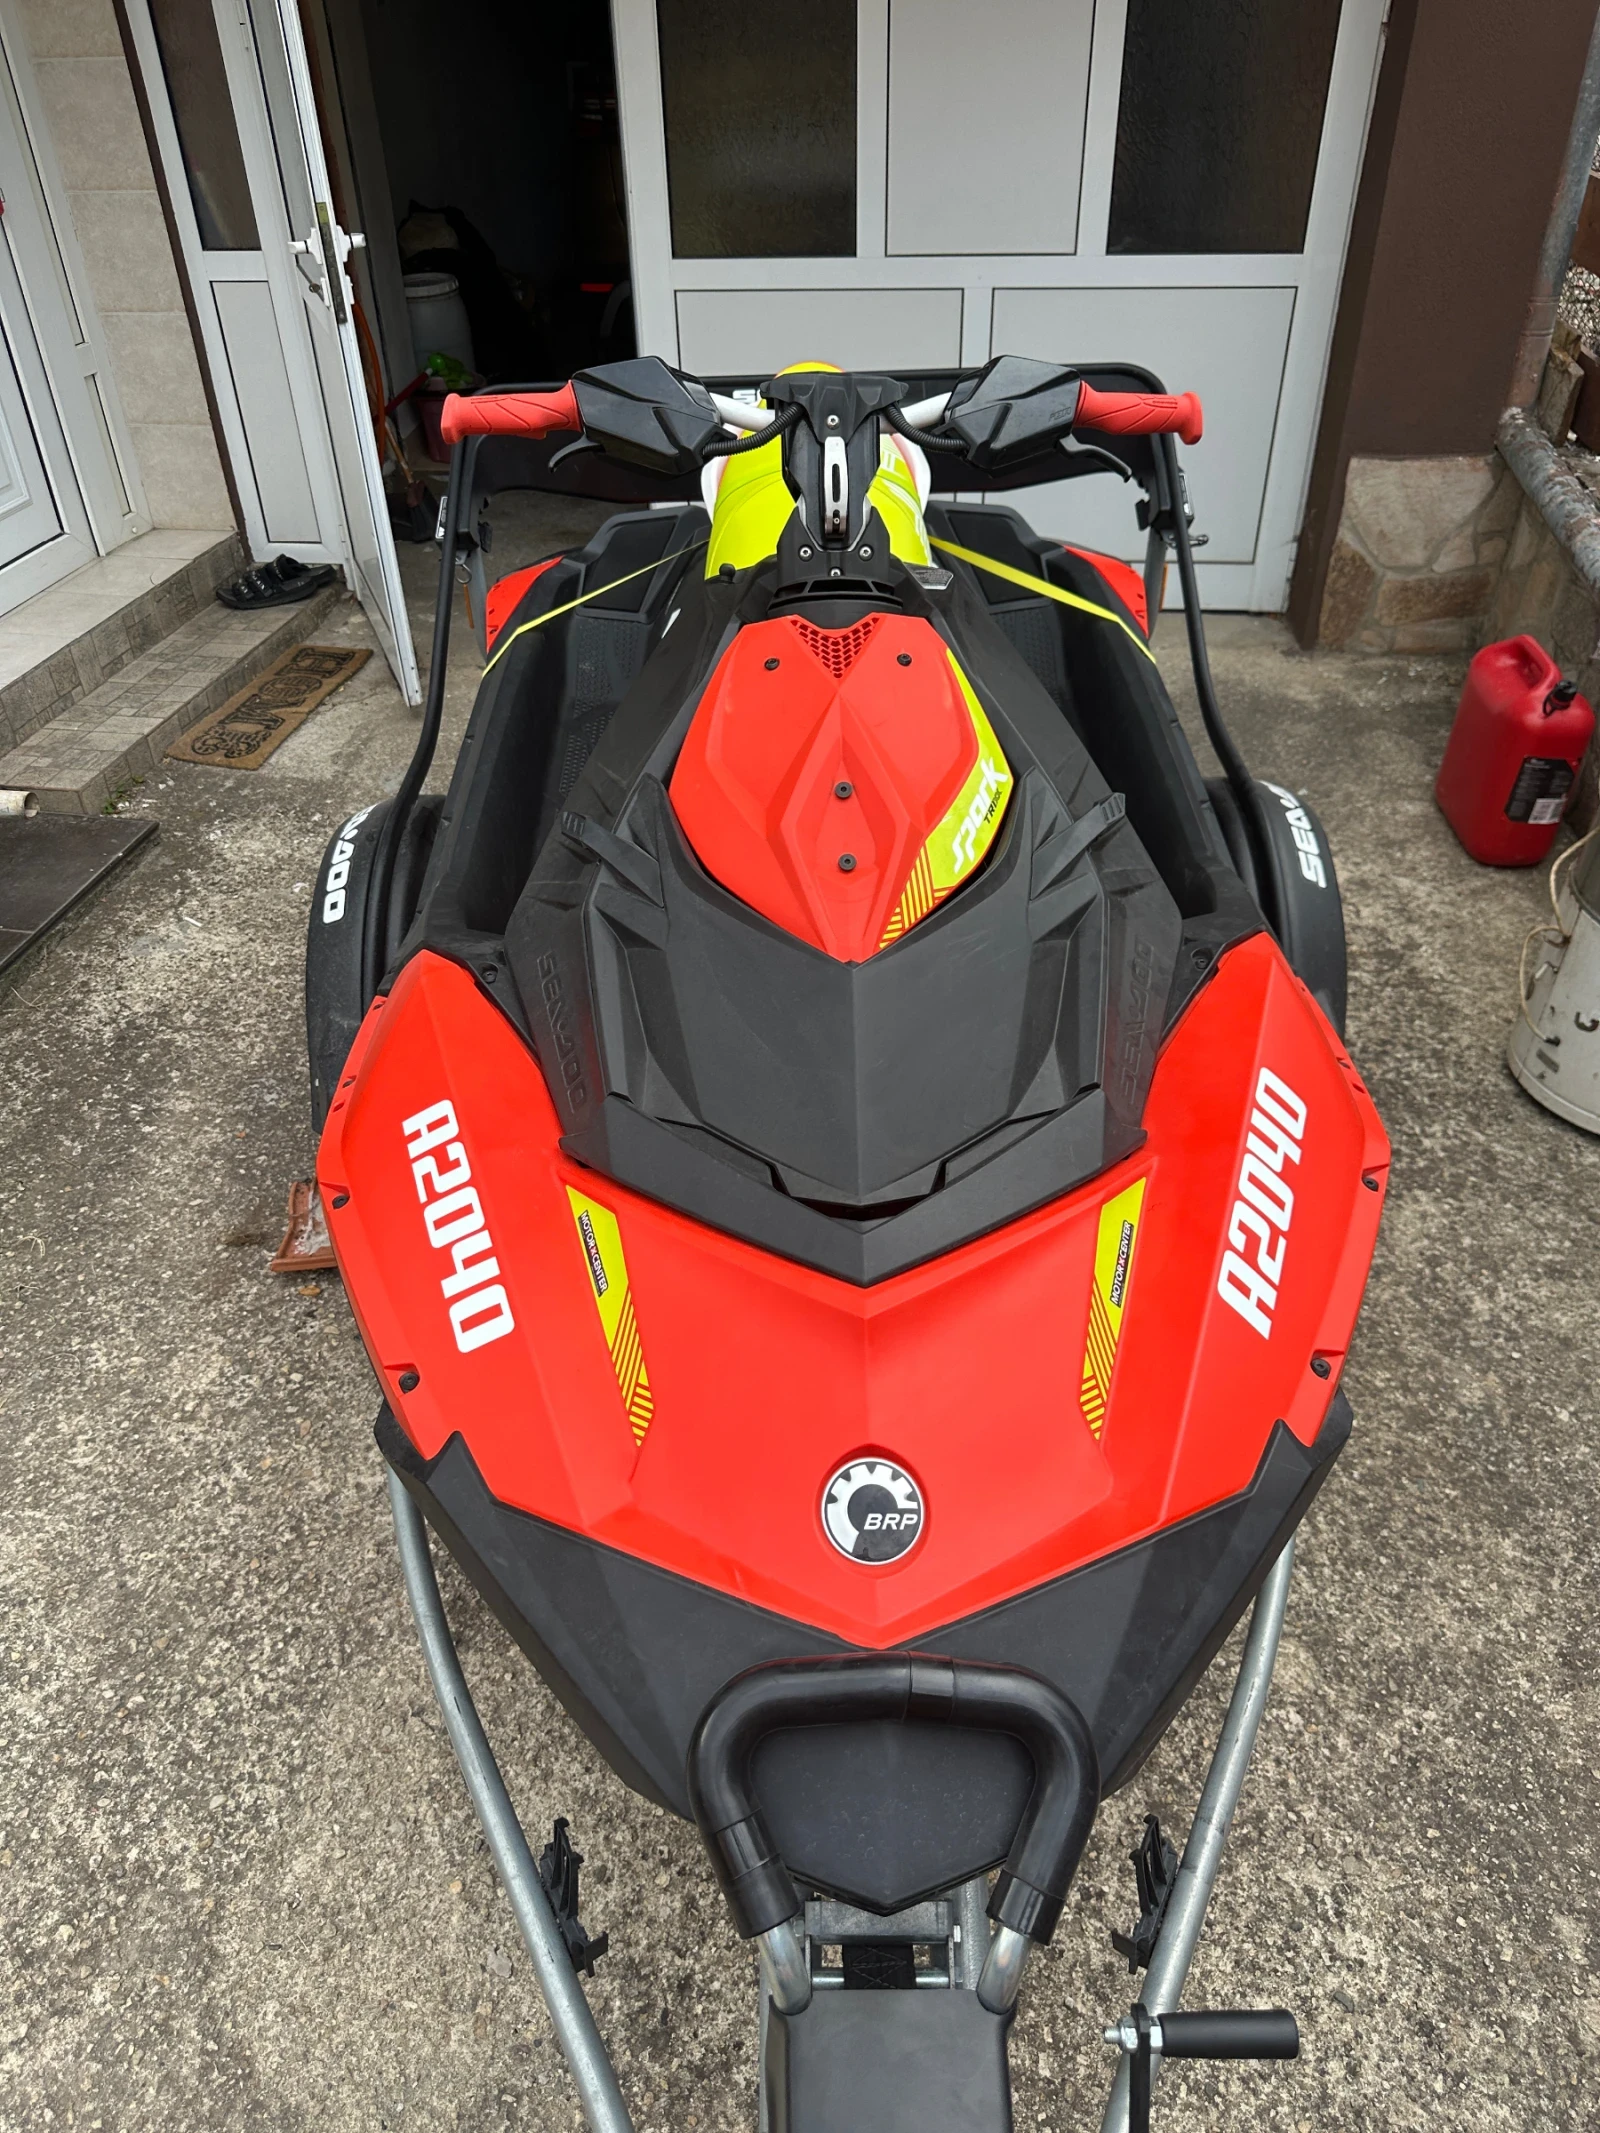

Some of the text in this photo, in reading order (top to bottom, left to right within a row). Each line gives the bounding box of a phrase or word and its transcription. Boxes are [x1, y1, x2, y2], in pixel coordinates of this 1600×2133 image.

[402, 1099, 515, 1353] A2040
[1217, 1066, 1308, 1340] A2040
[863, 1513, 918, 1530] BRP
